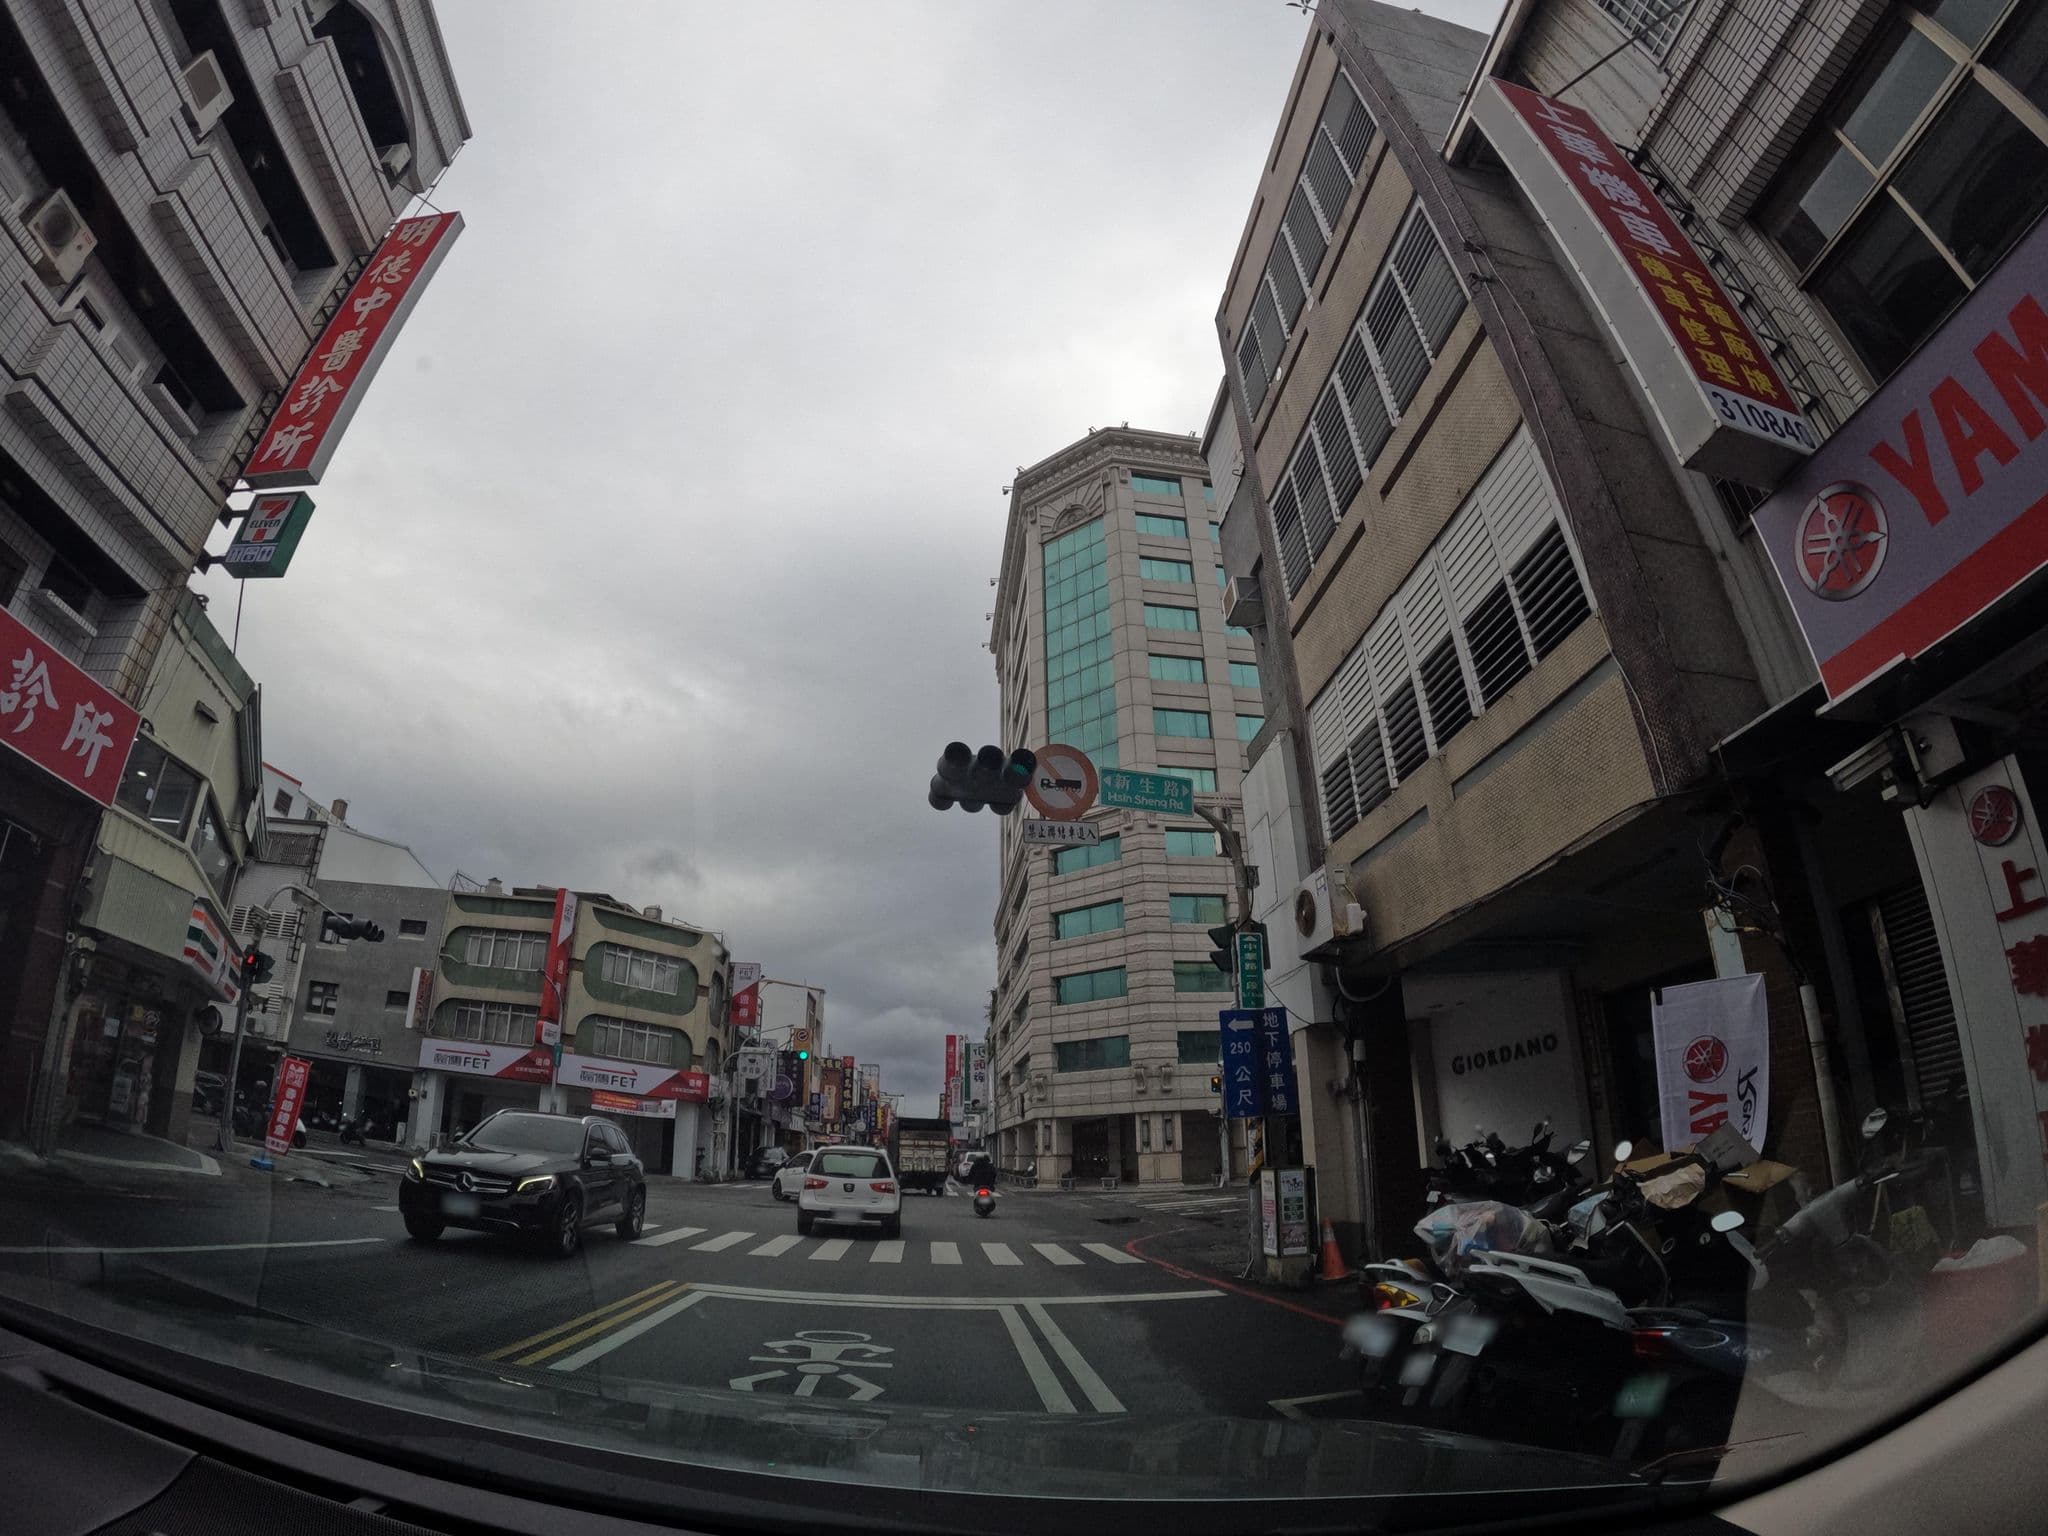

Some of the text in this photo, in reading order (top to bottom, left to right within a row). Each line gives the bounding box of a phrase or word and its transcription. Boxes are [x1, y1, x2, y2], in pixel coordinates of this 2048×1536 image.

[1636, 252, 1741, 387] 機車修理
[260, 216, 442, 467] 明德中醫診所
[1711, 391, 1817, 450] 310840
[0, 648, 115, 778] 診所
[1108, 791, 1184, 810] Hsin Sheng Rd
[1116, 773, 1179, 797] 新生路
[462, 1056, 491, 1070] FET
[1230, 1041, 1251, 1055] 250
[1262, 1012, 1288, 1112] 地下停車場
[1451, 1033, 1558, 1075] GIORDANO
[610, 1074, 637, 1089] FET
[1234, 1065, 1254, 1106] 公尺
